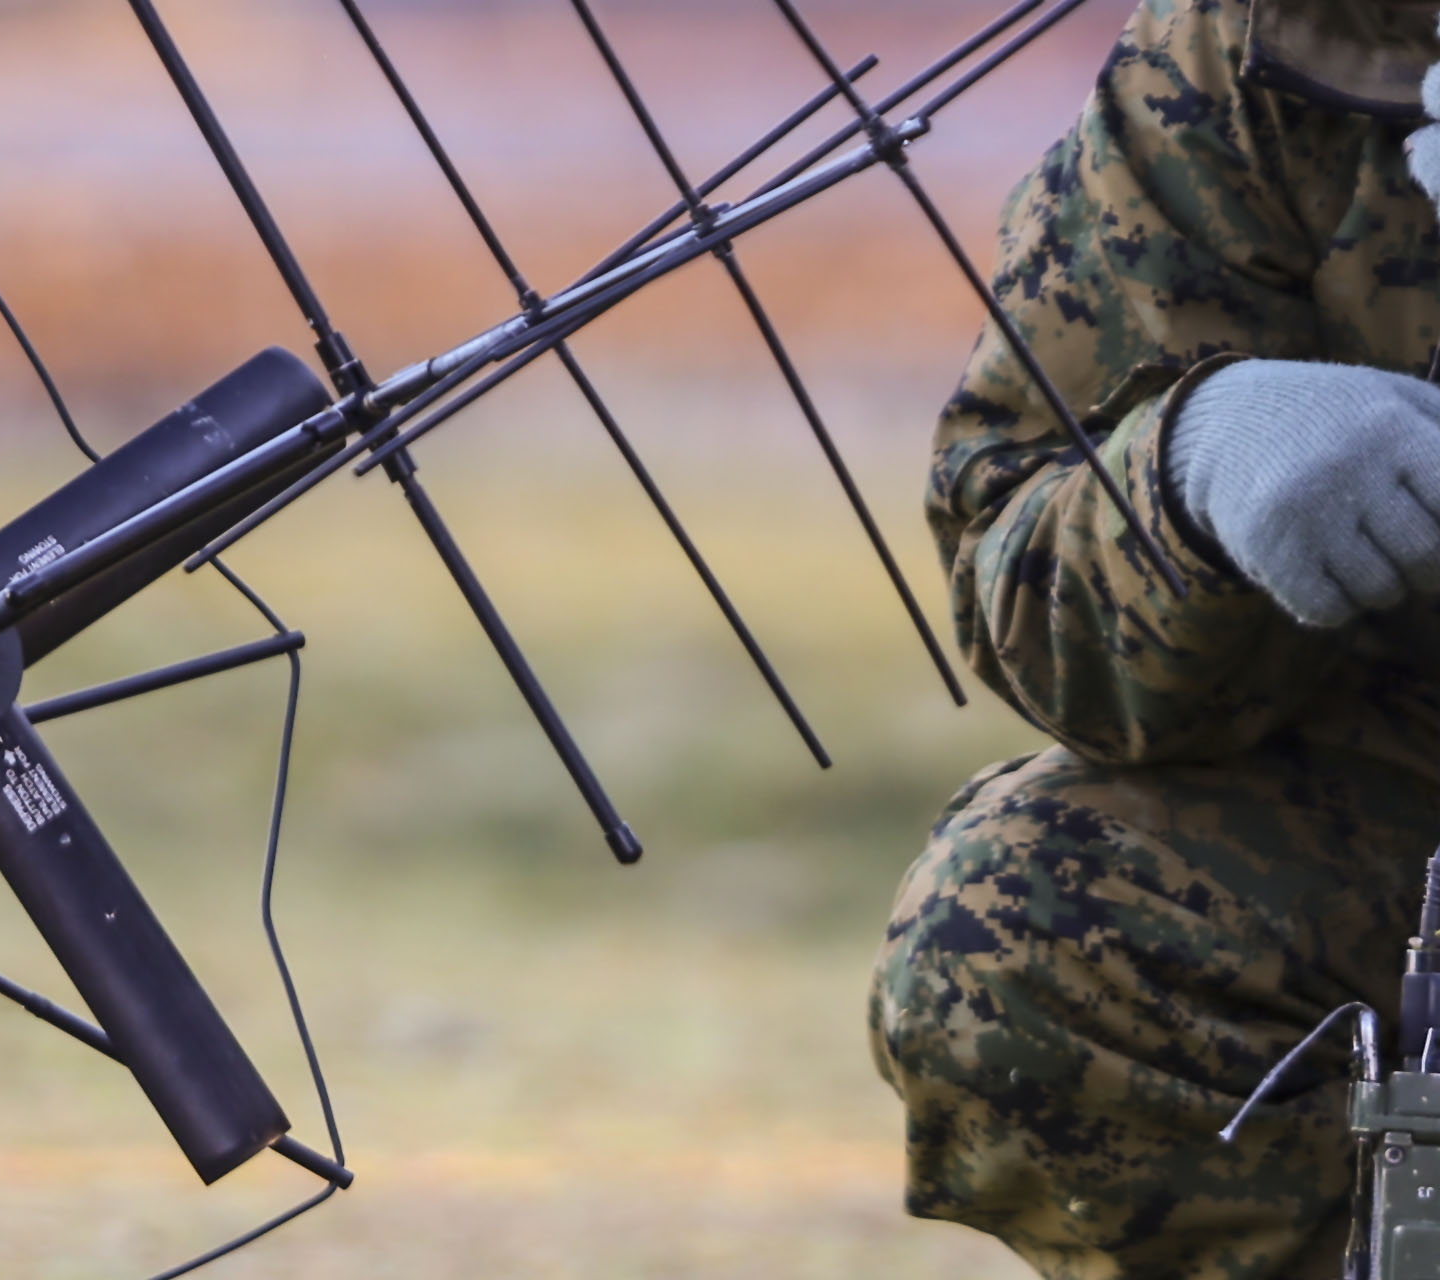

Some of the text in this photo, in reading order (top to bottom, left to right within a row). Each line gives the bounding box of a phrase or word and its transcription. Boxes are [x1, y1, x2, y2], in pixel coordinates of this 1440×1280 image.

[18, 534, 57, 564] STOWING
[6, 769, 46, 825] BUTTON TO
[14, 745, 61, 815] ELEMENT FOR
[20, 772, 54, 820] UNLATCH
[35, 763, 67, 809] STOWING
[2, 783, 37, 831] DEPRESS
[1417, 1186, 1434, 1199] J3
